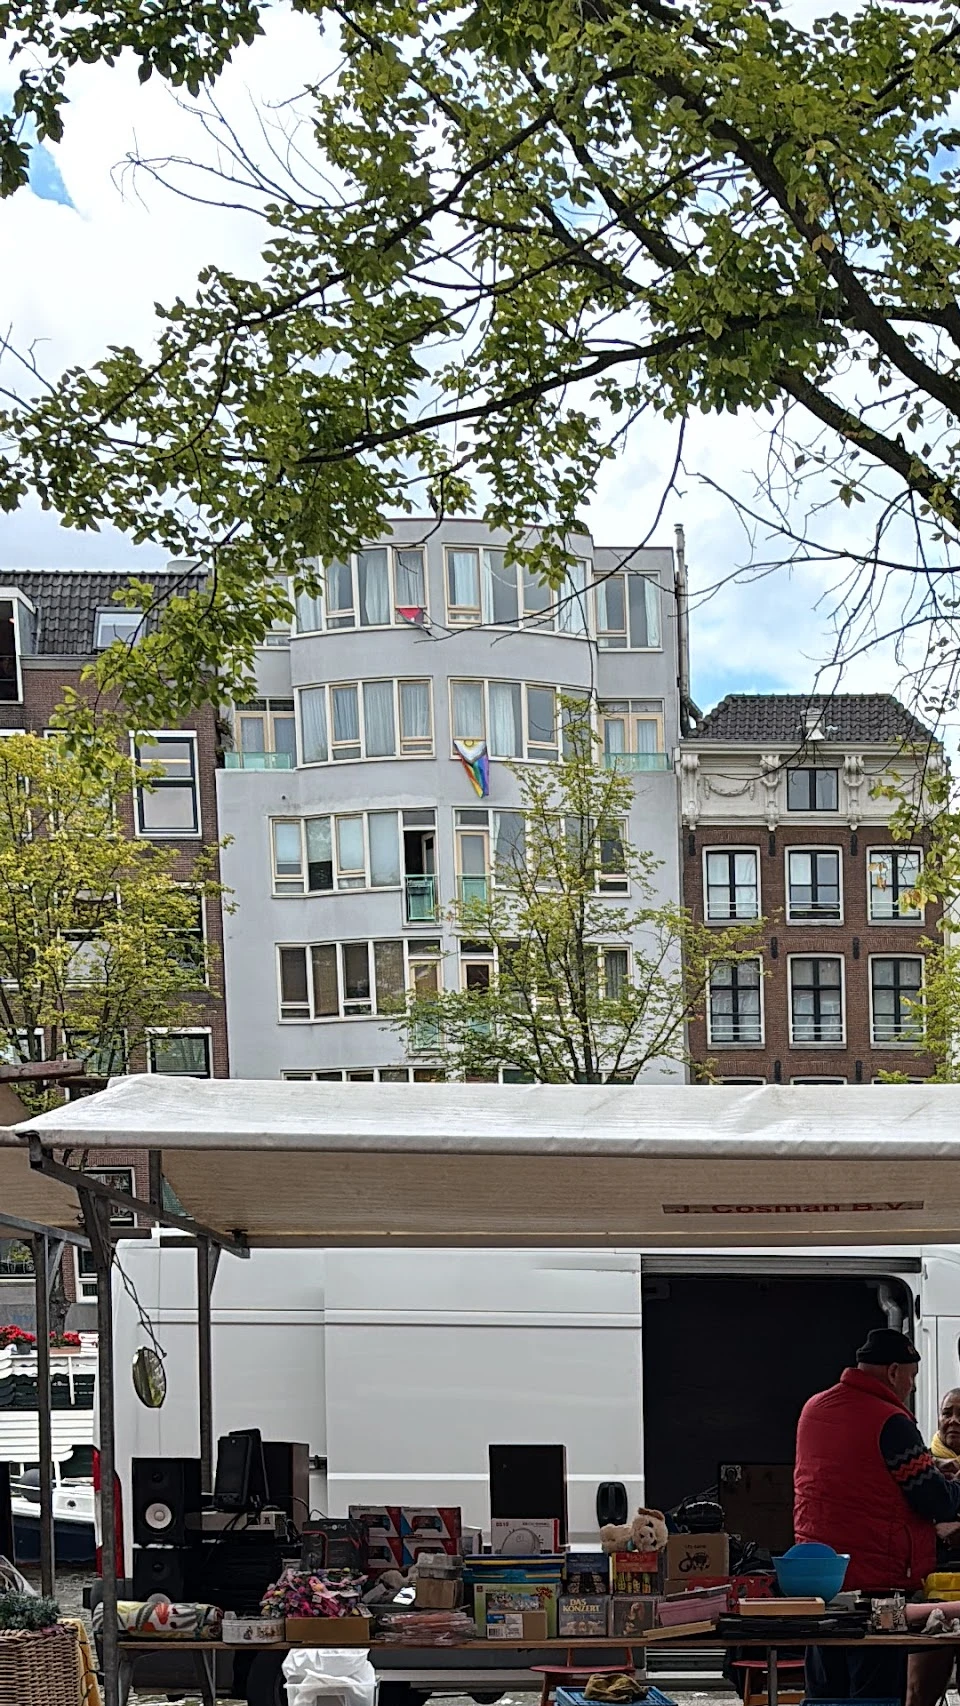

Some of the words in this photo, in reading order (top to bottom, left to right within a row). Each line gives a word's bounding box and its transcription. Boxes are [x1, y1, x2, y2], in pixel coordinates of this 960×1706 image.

[711, 1203, 840, 1213] Cosman
[570, 1598, 587, 1606] DAS
[562, 1604, 600, 1612] KONZERT
